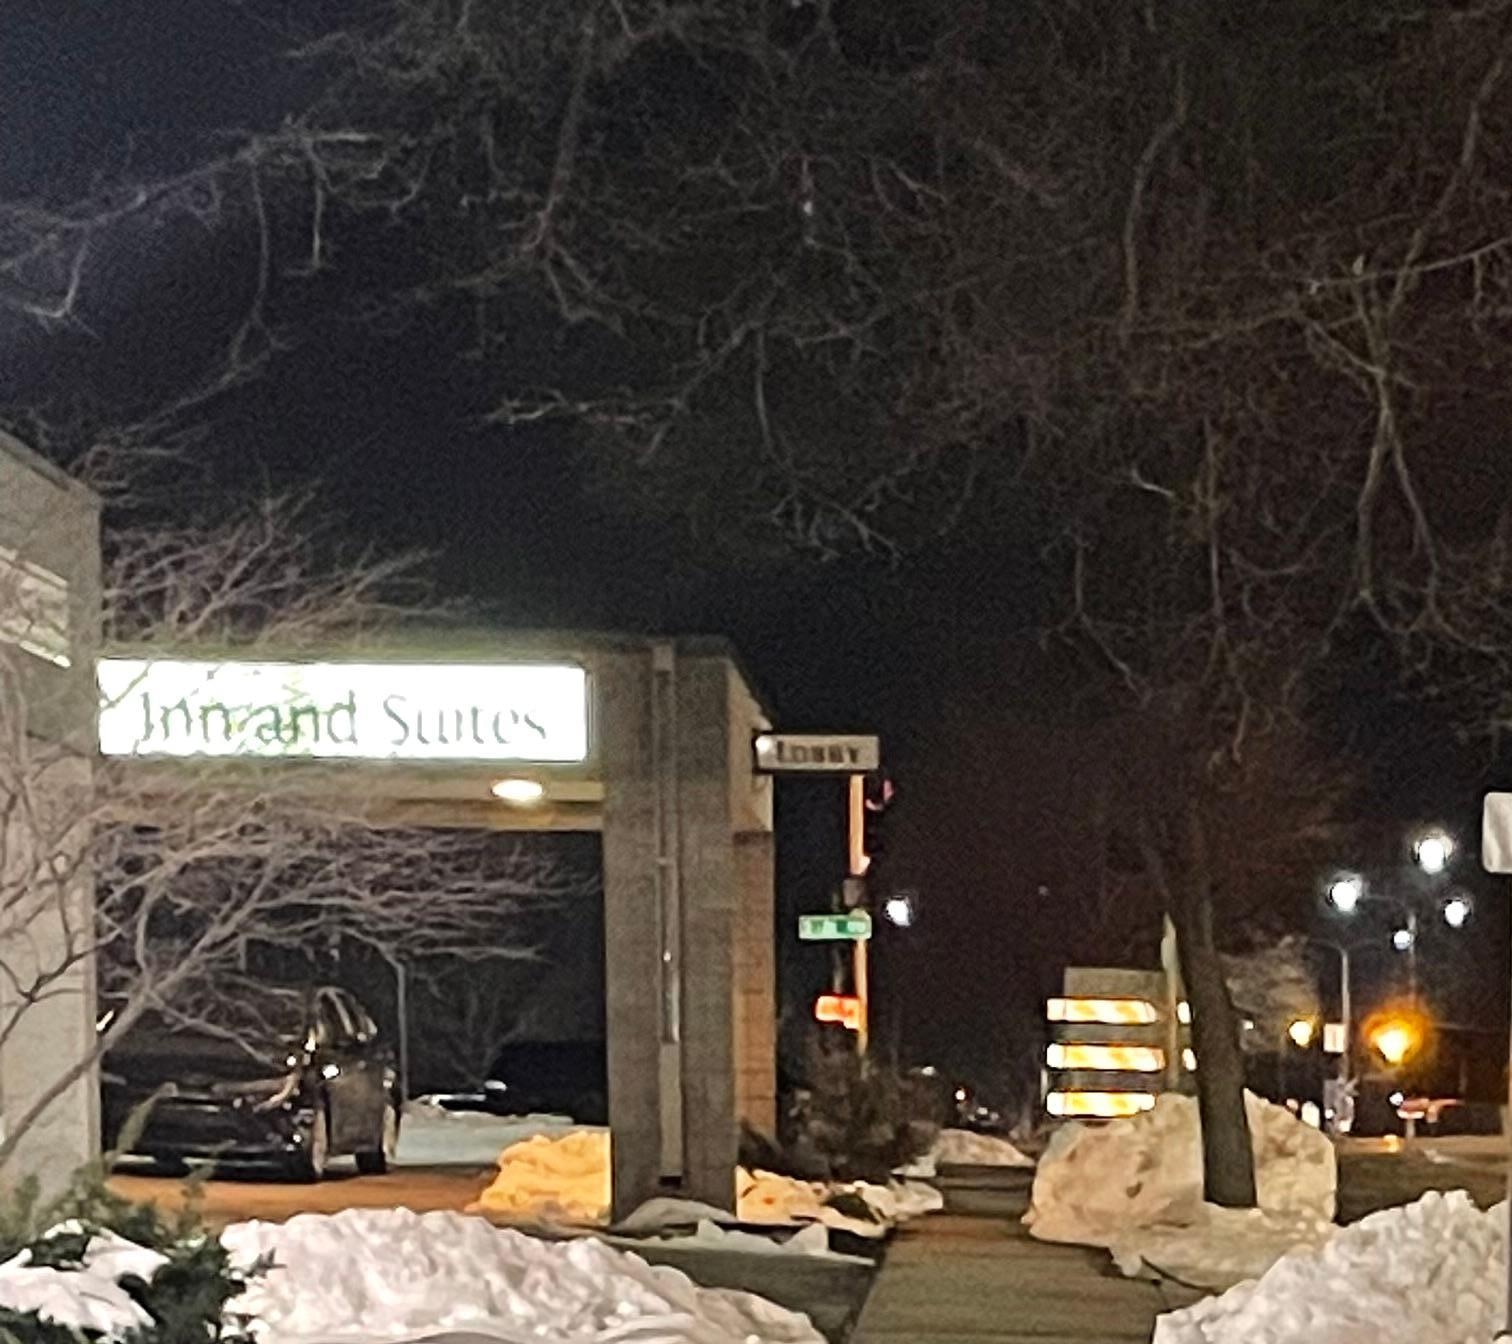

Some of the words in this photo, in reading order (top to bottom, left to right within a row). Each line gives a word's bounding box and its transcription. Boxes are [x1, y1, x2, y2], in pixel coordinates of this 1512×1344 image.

[141, 691, 233, 743] Inn
[254, 690, 358, 744] and
[382, 693, 547, 746] Suites
